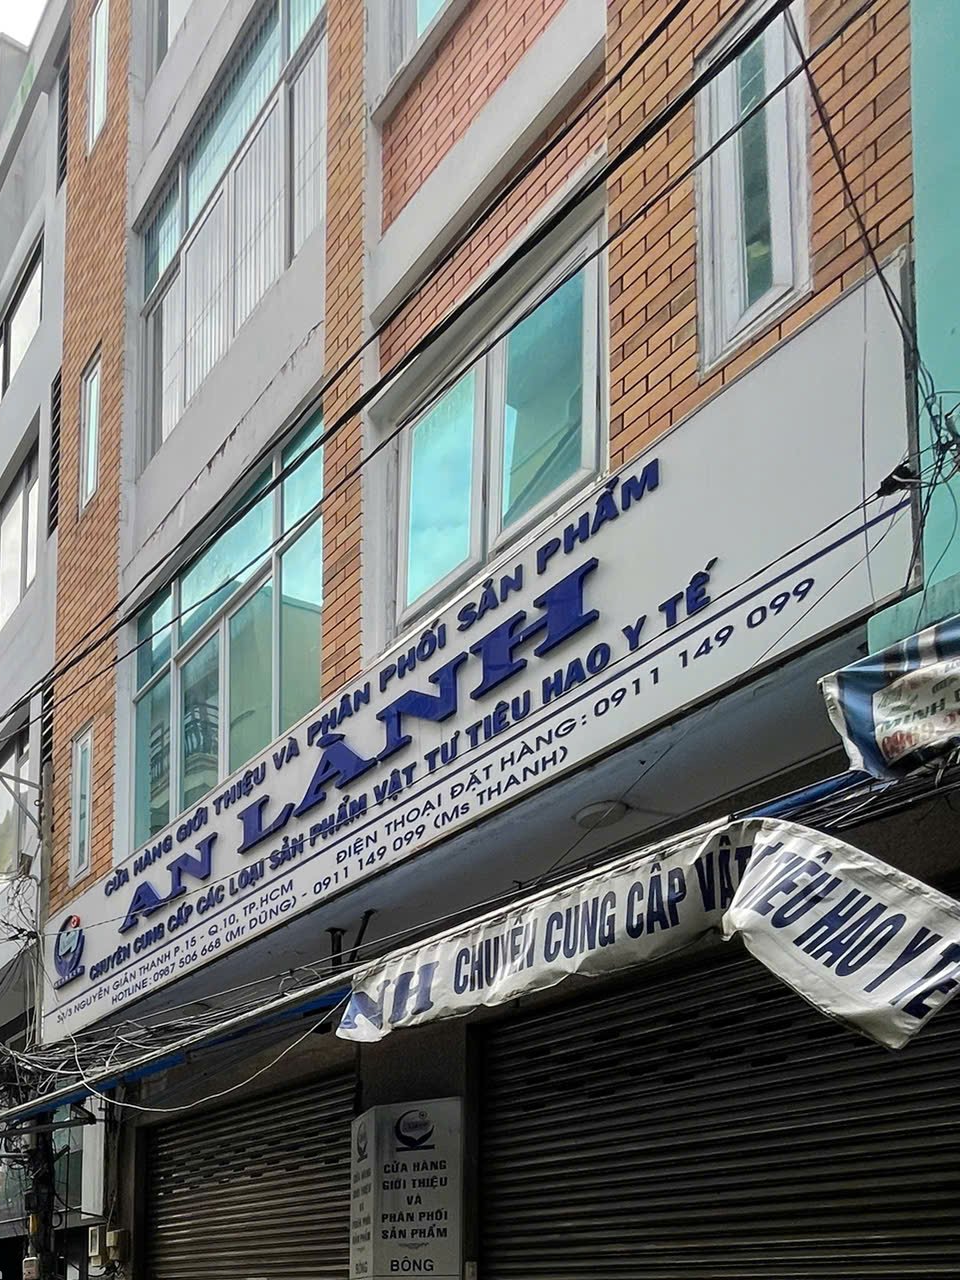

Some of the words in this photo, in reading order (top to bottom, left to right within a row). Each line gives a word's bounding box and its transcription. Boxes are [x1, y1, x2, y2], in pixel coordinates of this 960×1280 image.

[104, 866, 130, 896] CỬA
[134, 838, 173, 876] HÀNG
[176, 812, 208, 843] GIỚI
[213, 761, 266, 816] THIỆU
[272, 736, 300, 770] VÀ
[307, 682, 370, 746] PHÂN
[380, 618, 446, 693] PHỐI
[457, 564, 523, 632] SẢN
[537, 458, 660, 575] PHẨM
[89, 945, 131, 981] CHUYÊN
[133, 922, 164, 954] CUNG
[167, 901, 194, 933] CẤP
[196, 883, 225, 914] CÁC
[229, 865, 265, 896] LOẠI
[270, 835, 304, 870] SẢN
[310, 793, 367, 846] PHẨM
[373, 762, 417, 806] VẬT
[424, 730, 460, 774] TƯ
[465, 689, 531, 748] TIÊU
[542, 642, 611, 706] HAO
[622, 615, 647, 651] Y
[658, 557, 718, 628] TẾ
[118, 832, 218, 934] AN
[237, 557, 600, 855] LÀNH
[139, 950, 171, 978] THANH
[243, 879, 295, 918] TP.HCM
[336, 830, 378, 865] ĐIỆN
[385, 793, 442, 836] THOẠI
[450, 766, 492, 800] ĐẶT
[593, 667, 660, 718] 0911
[678, 625, 735, 669] 149
[745, 577, 816, 630] 099
[153, 962, 177, 984] 0987
[179, 951, 198, 969] 506
[201, 938, 221, 957] 668
[225, 925, 245, 945] (Mr
[248, 896, 297, 932] DŨNG)
[313, 868, 349, 895] 0911
[357, 846, 386, 872] 149
[392, 824, 426, 853] 099
[433, 803, 469, 829] (Ms
[476, 746, 568, 805] THANH)
[544, 891, 616, 963] CUNG
[793, 888, 907, 977] HAO
[863, 926, 944, 993] Y
[382, 1177, 406, 1191] GIỚI
[412, 1176, 448, 1190] THIỆU
[383, 1160, 408, 1174] CỬA
[413, 1160, 447, 1172] HÀNG
[406, 1194, 422, 1206] VÀ
[381, 1210, 414, 1223] PHÂN
[419, 1207, 448, 1221] PHỐI
[381, 1226, 407, 1240] SẢN
[411, 1224, 448, 1239] PHẨM
[390, 1256, 434, 1272] BÔNG
